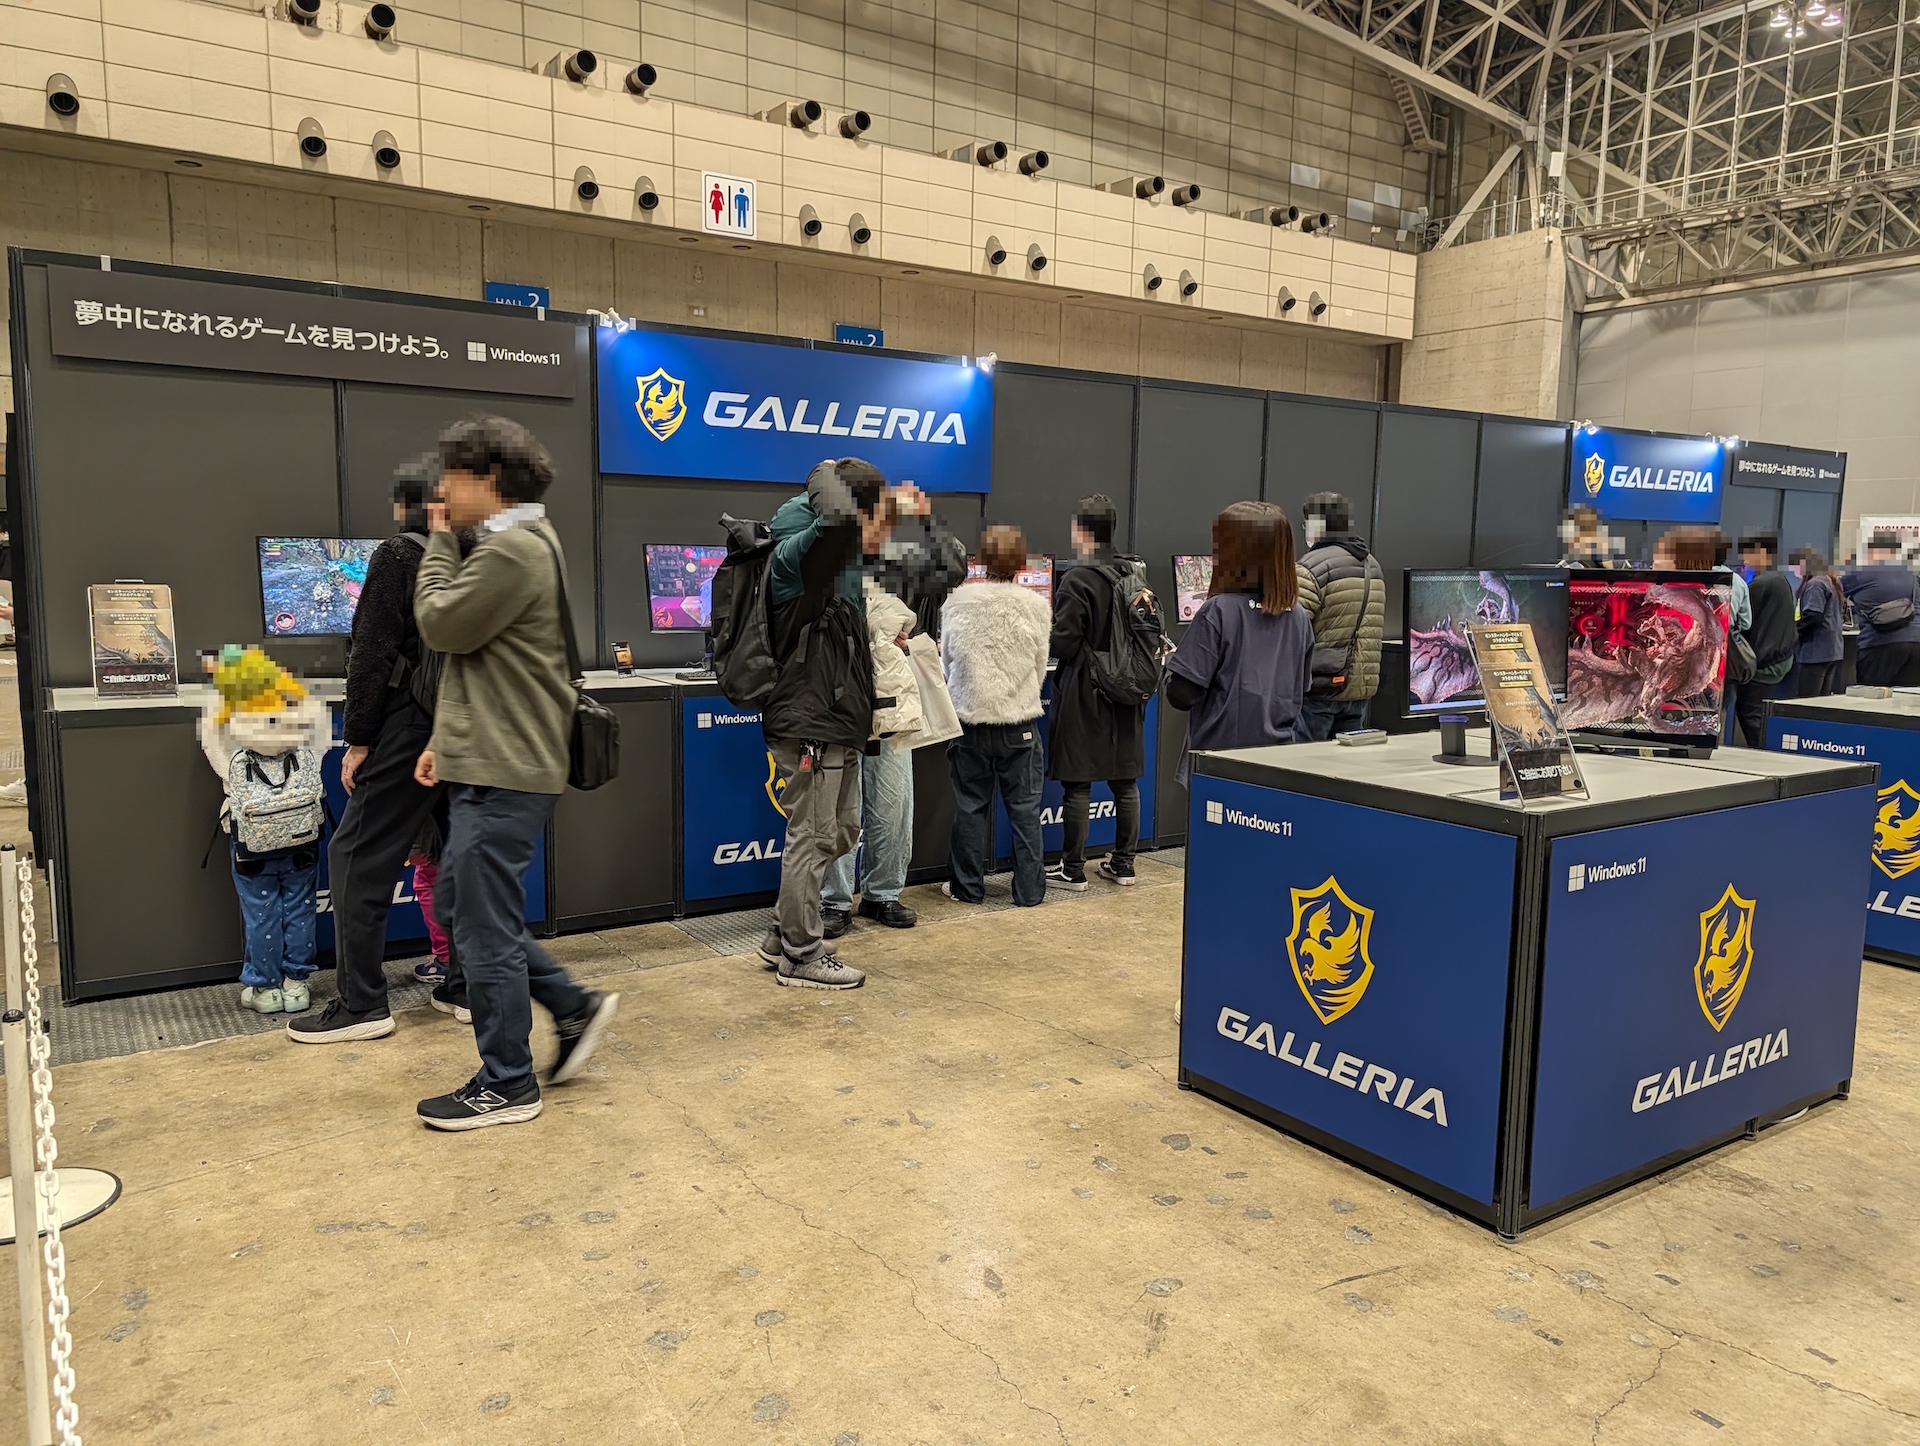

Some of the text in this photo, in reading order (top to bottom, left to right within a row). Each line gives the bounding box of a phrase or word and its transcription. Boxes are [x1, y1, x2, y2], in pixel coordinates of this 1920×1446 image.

[528, 292, 540, 308] 2
[74, 299, 449, 360] 夢中になれるゲームを見つけよう。
[490, 346, 561, 366] Windows 11
[702, 391, 967, 446] GALLERIA
[1609, 465, 1713, 493] GALLERIA
[103, 673, 171, 683] ご自由にお取り下さい
[714, 713, 757, 725] Windows
[1802, 738, 1866, 756] Windows 11
[1518, 764, 1574, 781] ご自由にお取り下さい
[1226, 808, 1292, 837] Windows 11
[1588, 856, 1647, 883] Windows 11
[1216, 1006, 1449, 1128] GALLERIA
[1631, 1027, 1789, 1114] GALLERIA
